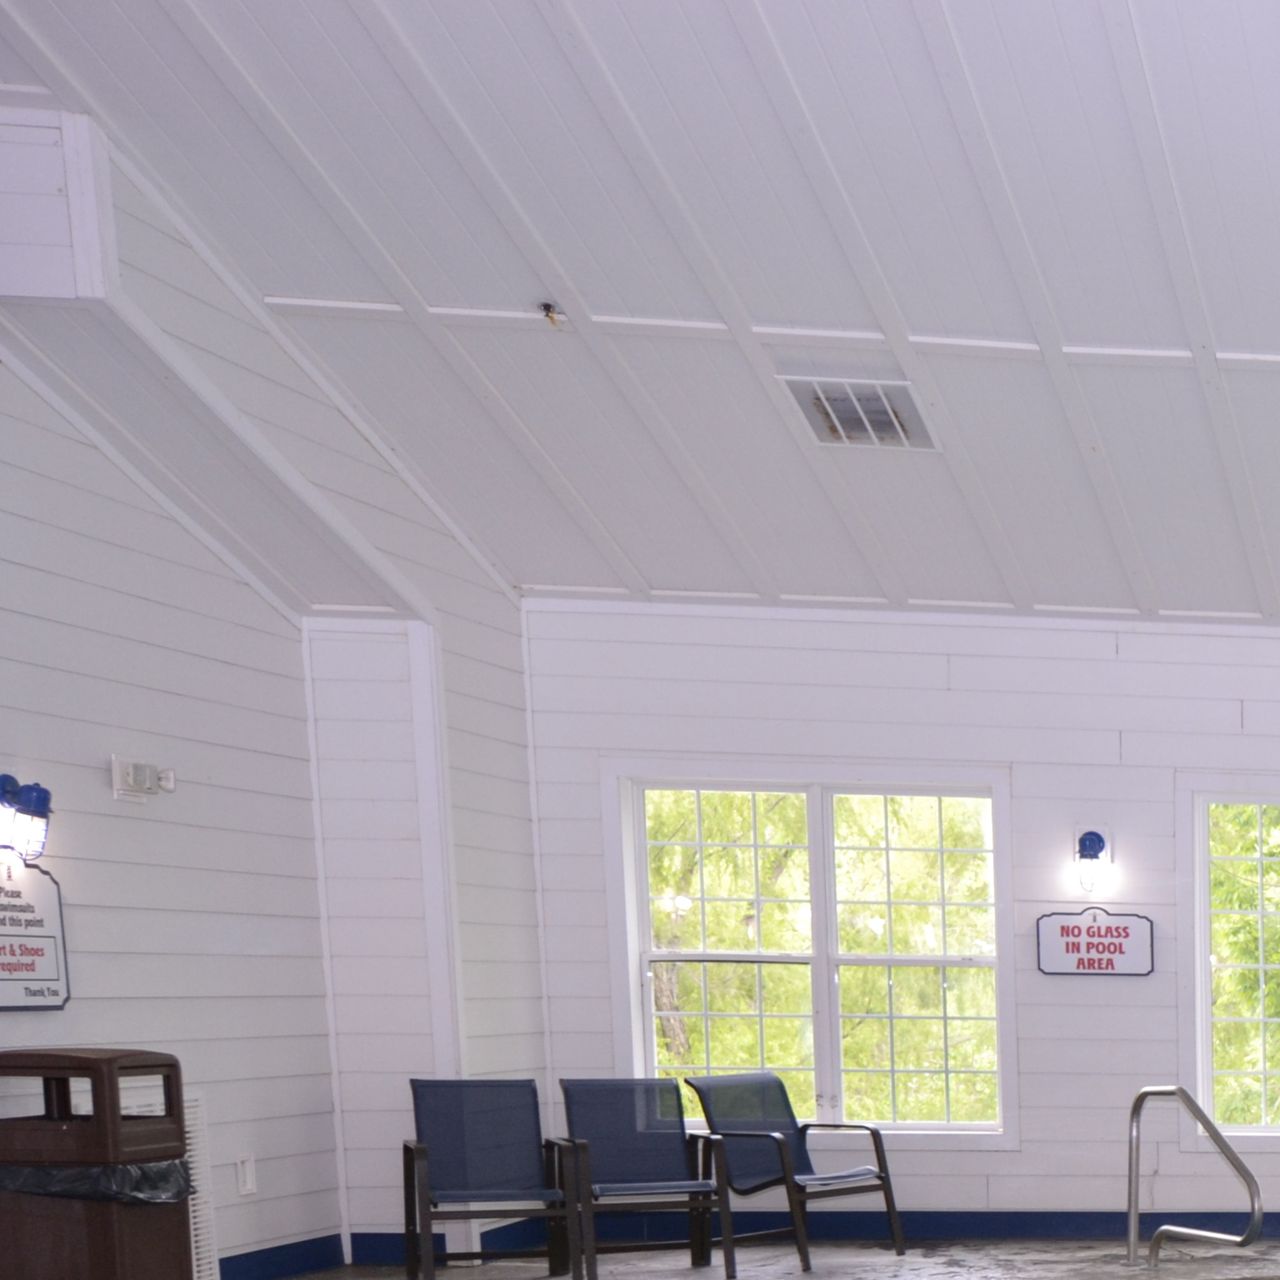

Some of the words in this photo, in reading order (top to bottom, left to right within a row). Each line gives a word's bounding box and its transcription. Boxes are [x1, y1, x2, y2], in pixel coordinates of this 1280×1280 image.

[8, 915, 23, 928] this
[24, 917, 44, 930] point
[1060, 925, 1082, 938] NO
[1086, 925, 1130, 939] GLASS
[19, 944, 45, 957] Shoes
[1065, 941, 1080, 954] IN
[1086, 941, 1126, 955] POOL
[1076, 957, 1115, 970] AREA
